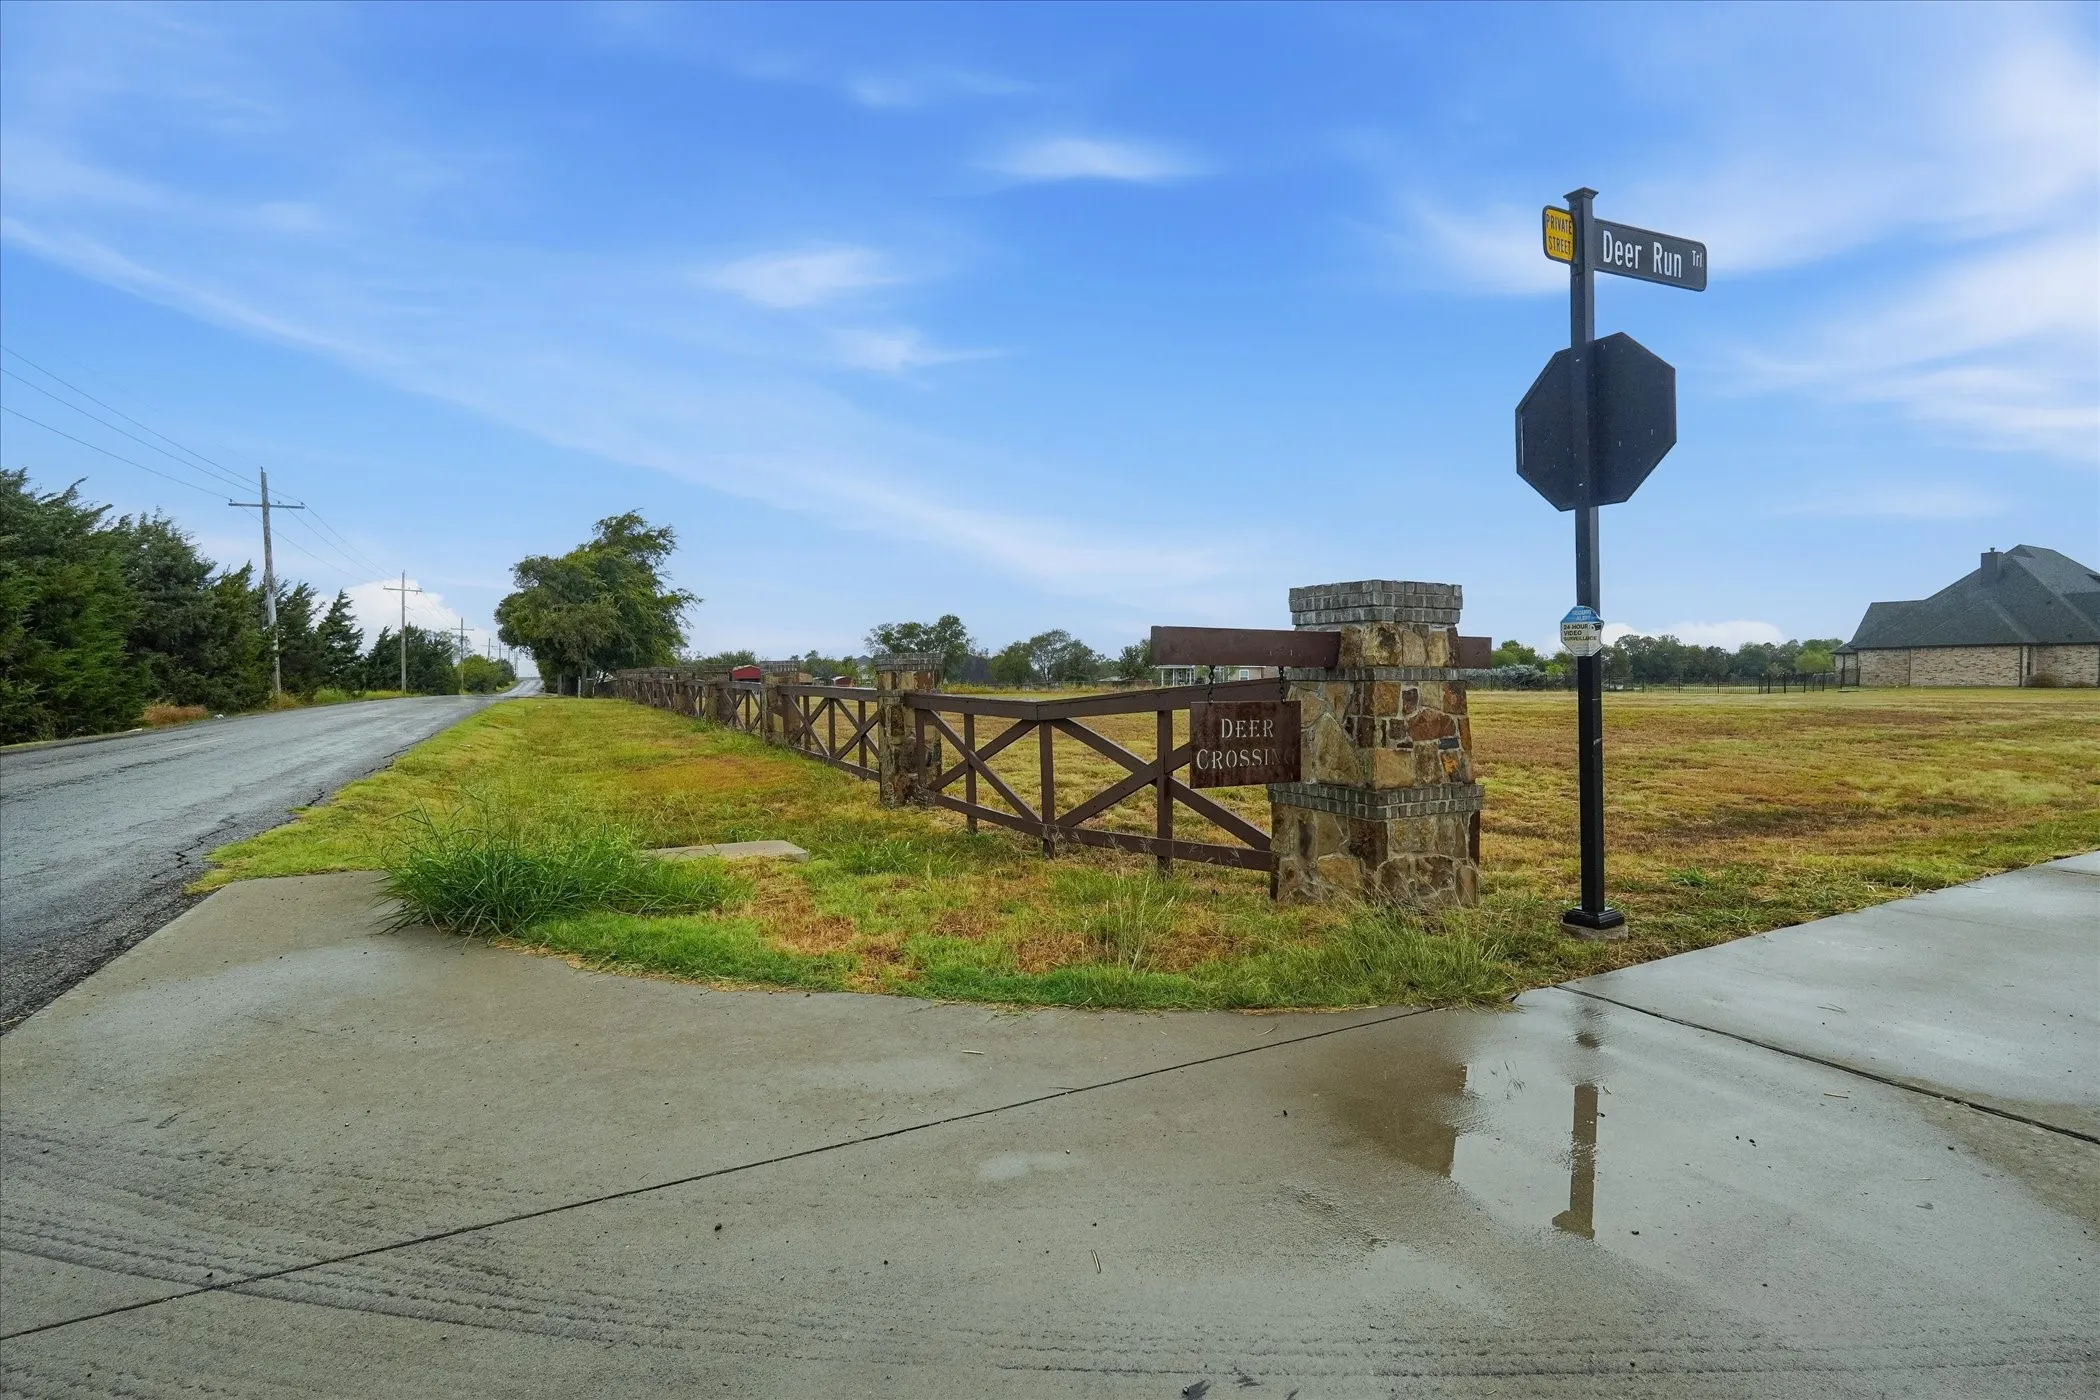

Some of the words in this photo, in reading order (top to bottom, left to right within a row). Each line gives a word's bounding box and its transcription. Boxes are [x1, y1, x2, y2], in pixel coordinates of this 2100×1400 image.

[1546, 213, 1572, 235] PRIVATE
[1548, 235, 1571, 255] STREET
[1603, 230, 1642, 269] Deer
[1653, 241, 1682, 278] Run
[1692, 250, 1702, 268] Trl
[1221, 718, 1274, 739] DEER
